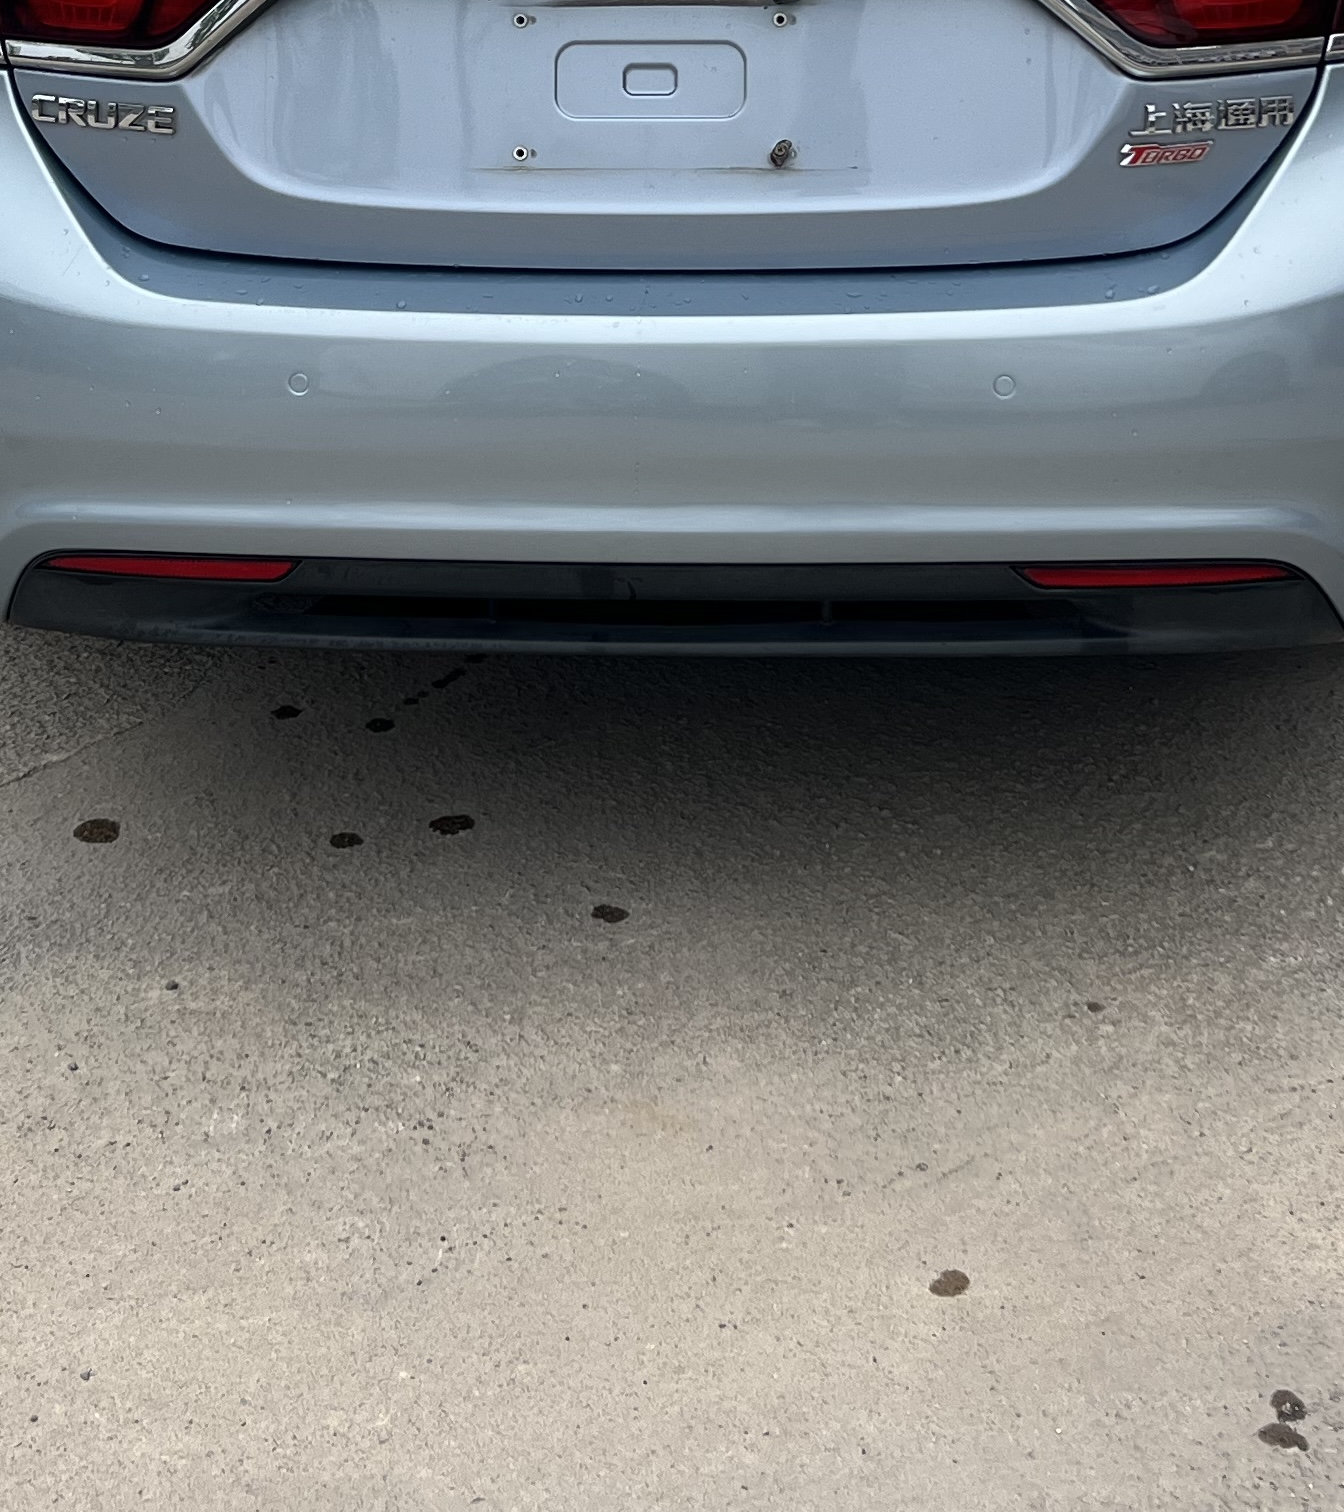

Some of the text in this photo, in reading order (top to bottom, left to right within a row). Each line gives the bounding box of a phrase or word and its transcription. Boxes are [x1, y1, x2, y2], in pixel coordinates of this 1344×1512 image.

[31, 94, 176, 136] CRUZE
[1128, 95, 1294, 137] 上海通用
[1124, 142, 1211, 166] TURBO
